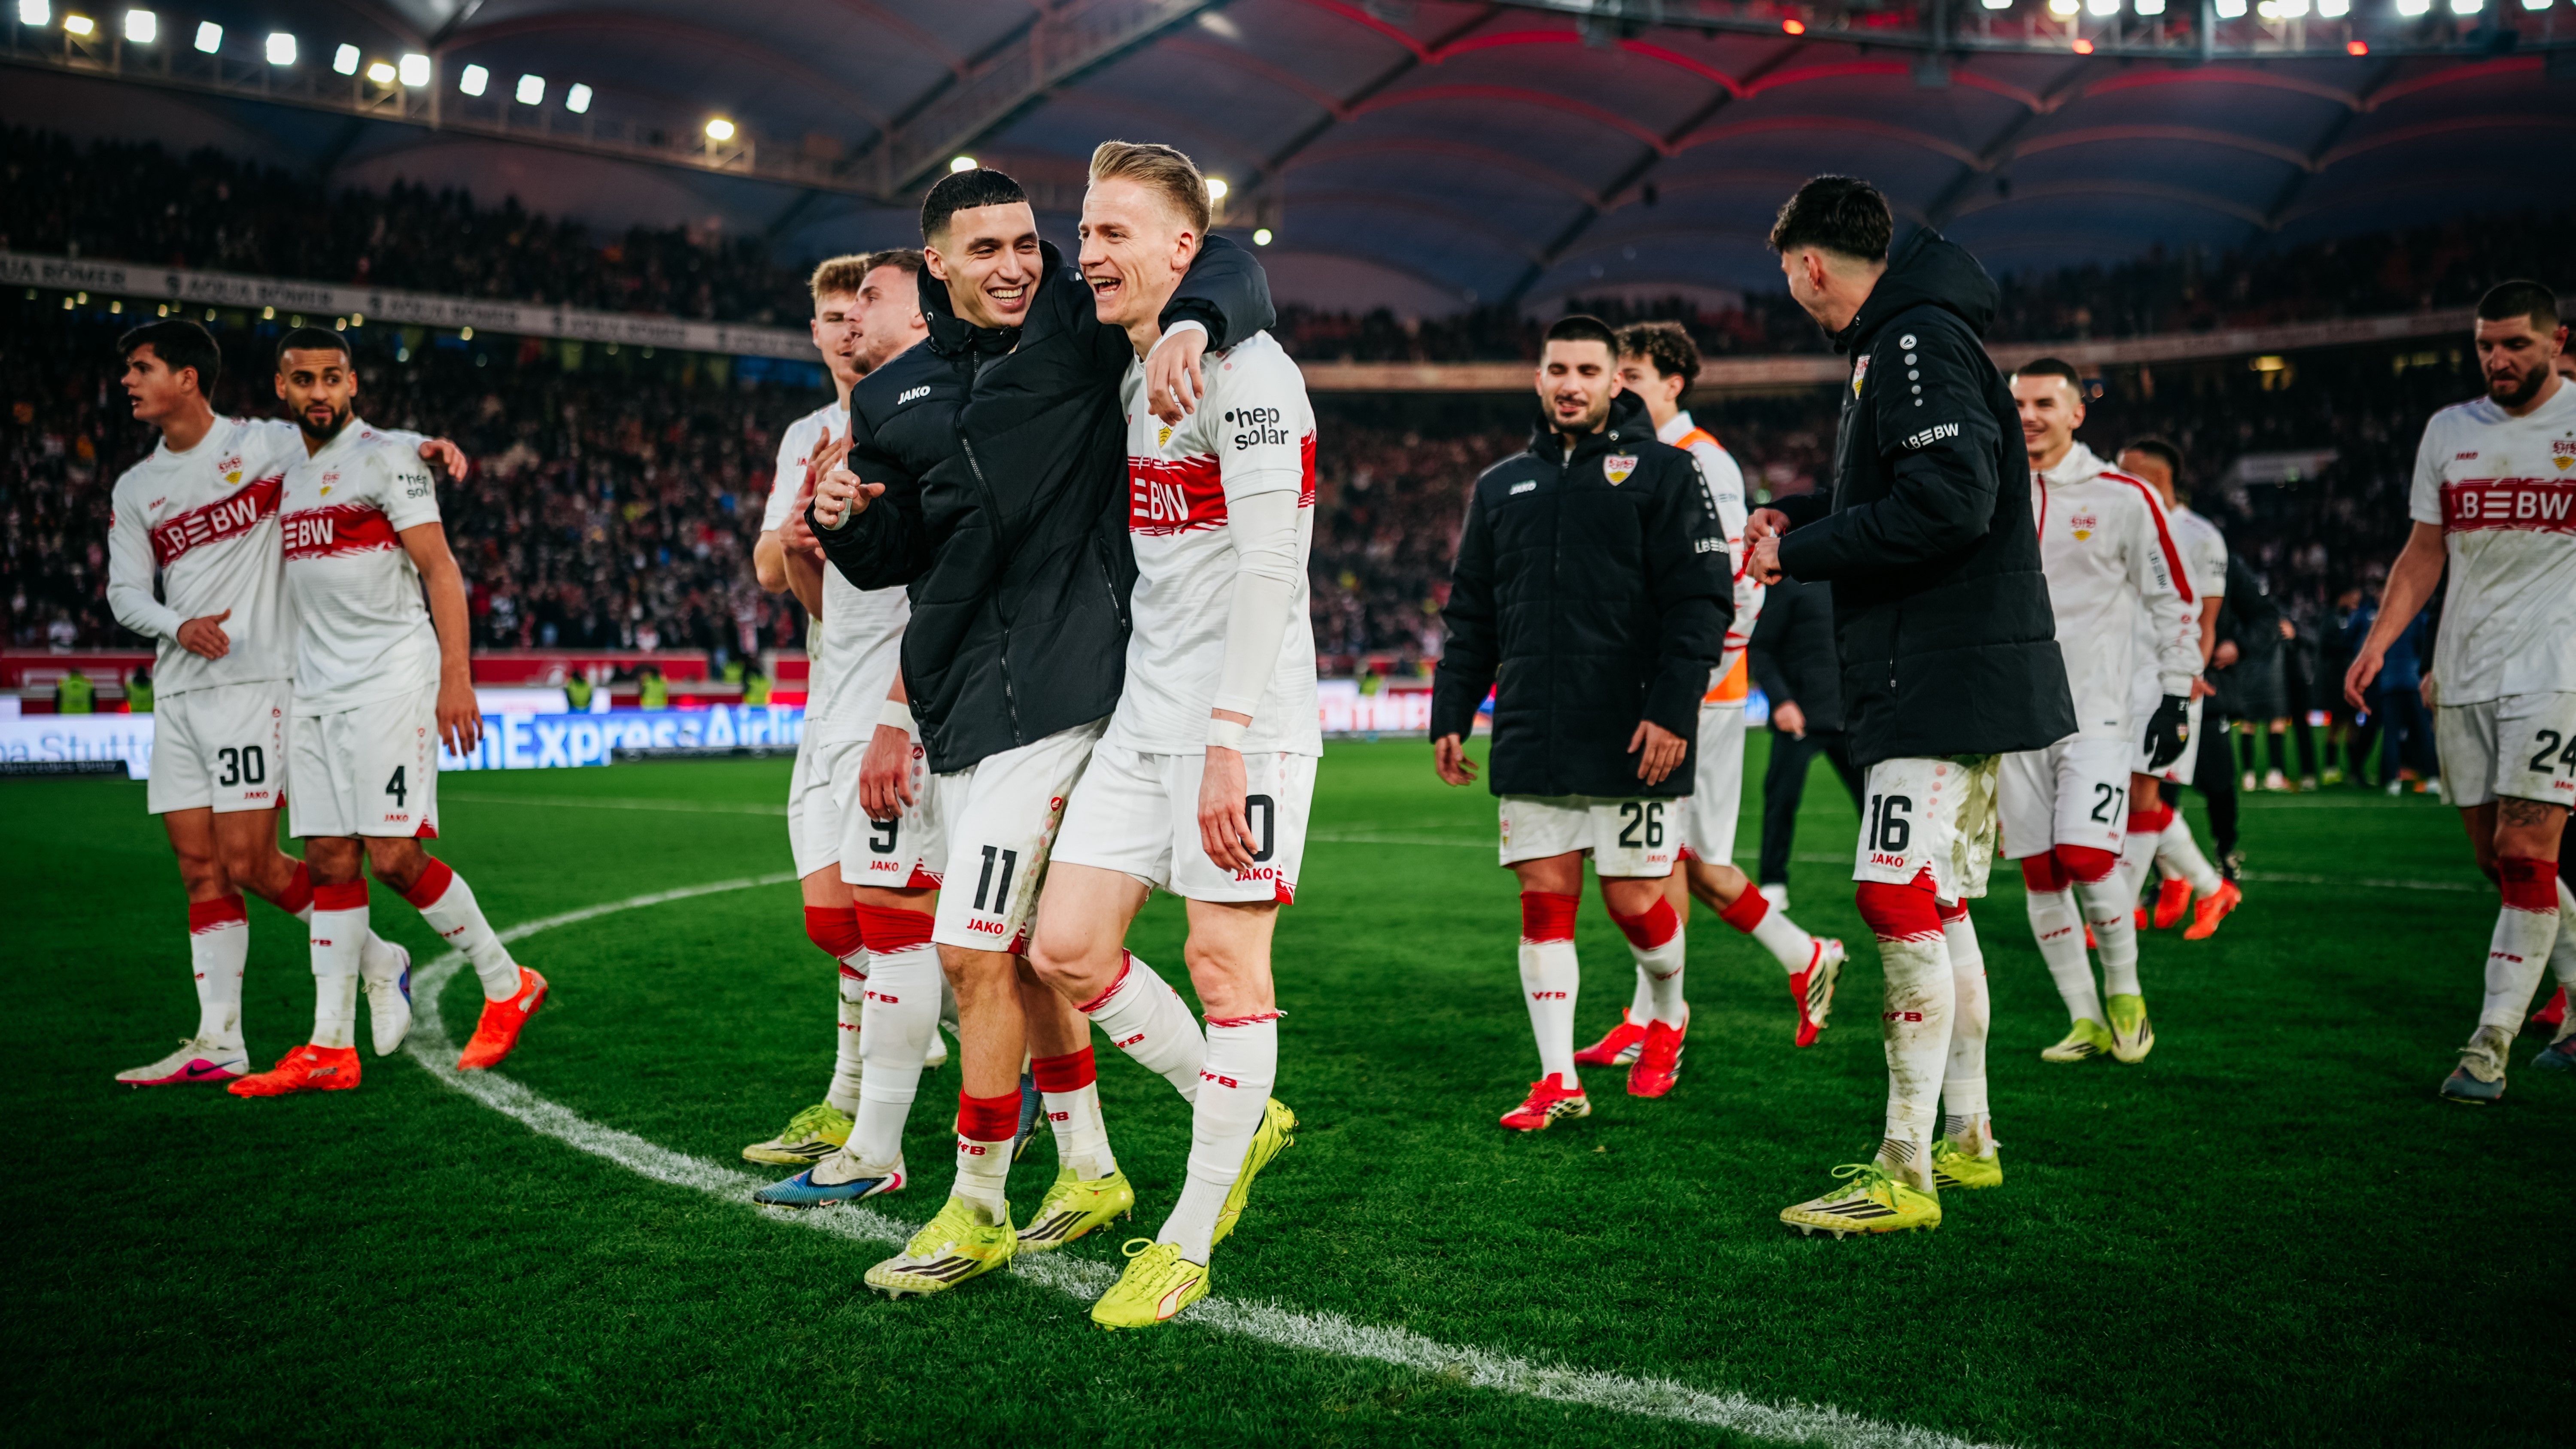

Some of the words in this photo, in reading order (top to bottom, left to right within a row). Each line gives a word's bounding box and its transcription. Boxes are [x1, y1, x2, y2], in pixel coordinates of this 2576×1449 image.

[897, 386, 931, 405] JAKO
[1236, 408, 1279, 428] hep
[1235, 425, 1288, 450] solar
[1509, 480, 1537, 495] JAKO
[2529, 729, 2576, 778] 24
[218, 746, 265, 786] 30
[244, 791, 269, 800] JAKO
[386, 766, 407, 808] 4
[2091, 783, 2124, 828] 27
[384, 814, 409, 823] JAKO
[1619, 802, 1664, 849] 26
[1868, 794, 1912, 851] 16
[869, 817, 898, 853] 9
[869, 860, 899, 872] JAKO
[1646, 855, 1668, 863] JAKO
[1871, 853, 1904, 869] JAKO
[973, 845, 1017, 915] 11
[1235, 867, 1274, 882] JAKO
[966, 918, 1004, 936] JAKO
[1531, 991, 1567, 1002] VfB
[1048, 1111, 1069, 1122] fB
